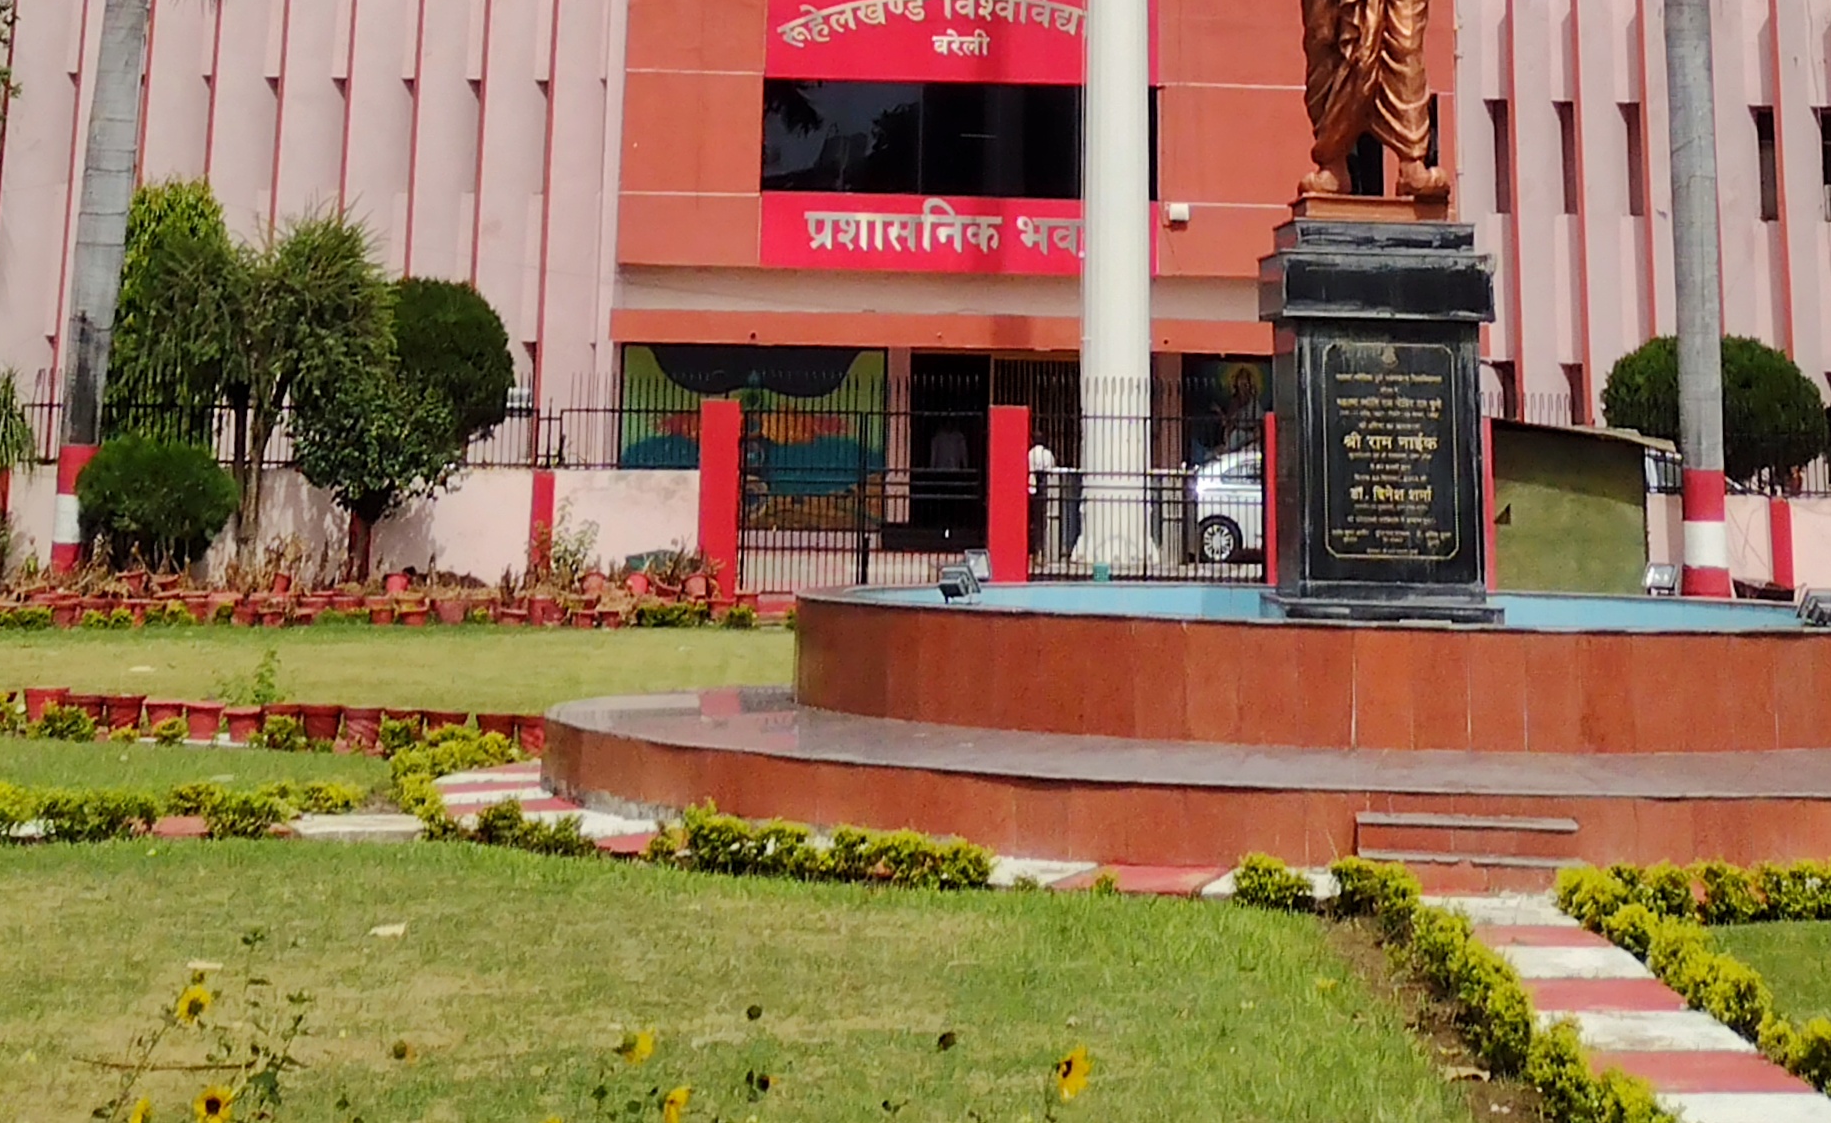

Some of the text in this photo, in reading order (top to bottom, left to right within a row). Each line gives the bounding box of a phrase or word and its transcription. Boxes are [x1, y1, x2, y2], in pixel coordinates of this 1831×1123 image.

[804, 198, 1086, 257] प्रशासनिक भव
[1343, 431, 1362, 450] श्री
[1366, 435, 1392, 450] राम
